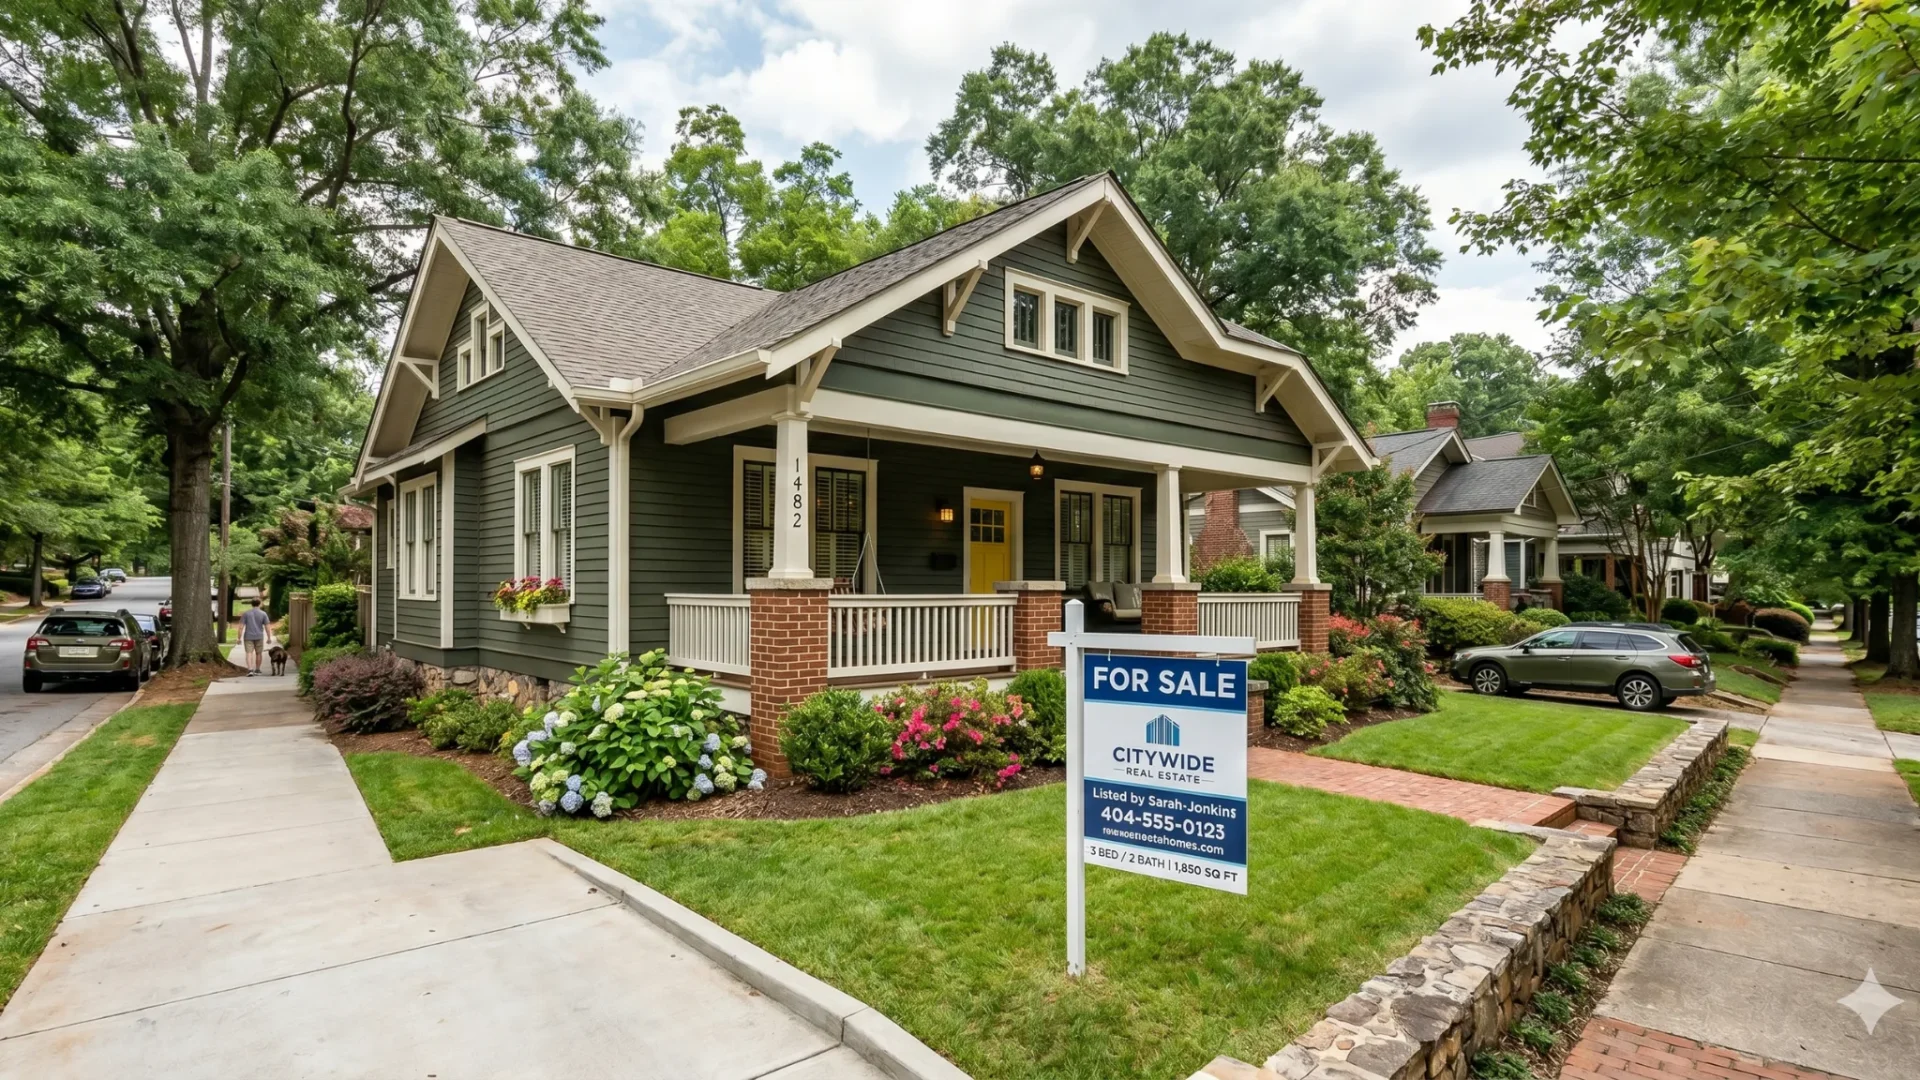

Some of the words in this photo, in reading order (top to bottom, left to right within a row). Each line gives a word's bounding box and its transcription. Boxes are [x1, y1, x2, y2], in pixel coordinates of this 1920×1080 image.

[793, 457, 803, 528] 1482
[1093, 666, 1149, 693] FOR
[1158, 669, 1236, 699] SALE
[1112, 746, 1215, 773] CITYWIDE
[1126, 767, 1154, 778] REAL
[1158, 771, 1200, 784] ESTATE
[1093, 787, 1127, 802] Listed
[1130, 792, 1145, 806] by
[1148, 795, 1237, 819] Sarah-Jonkins
[1101, 806, 1225, 840] 404-555-0123
[1090, 846, 1096, 856] 3
[1098, 847, 1119, 860] BED
[1129, 853, 1135, 863] 2
[1137, 855, 1165, 869] BATH
[1174, 861, 1201, 876] 1,850
[1204, 867, 1221, 879] SQ
[1223, 871, 1238, 883] FT
